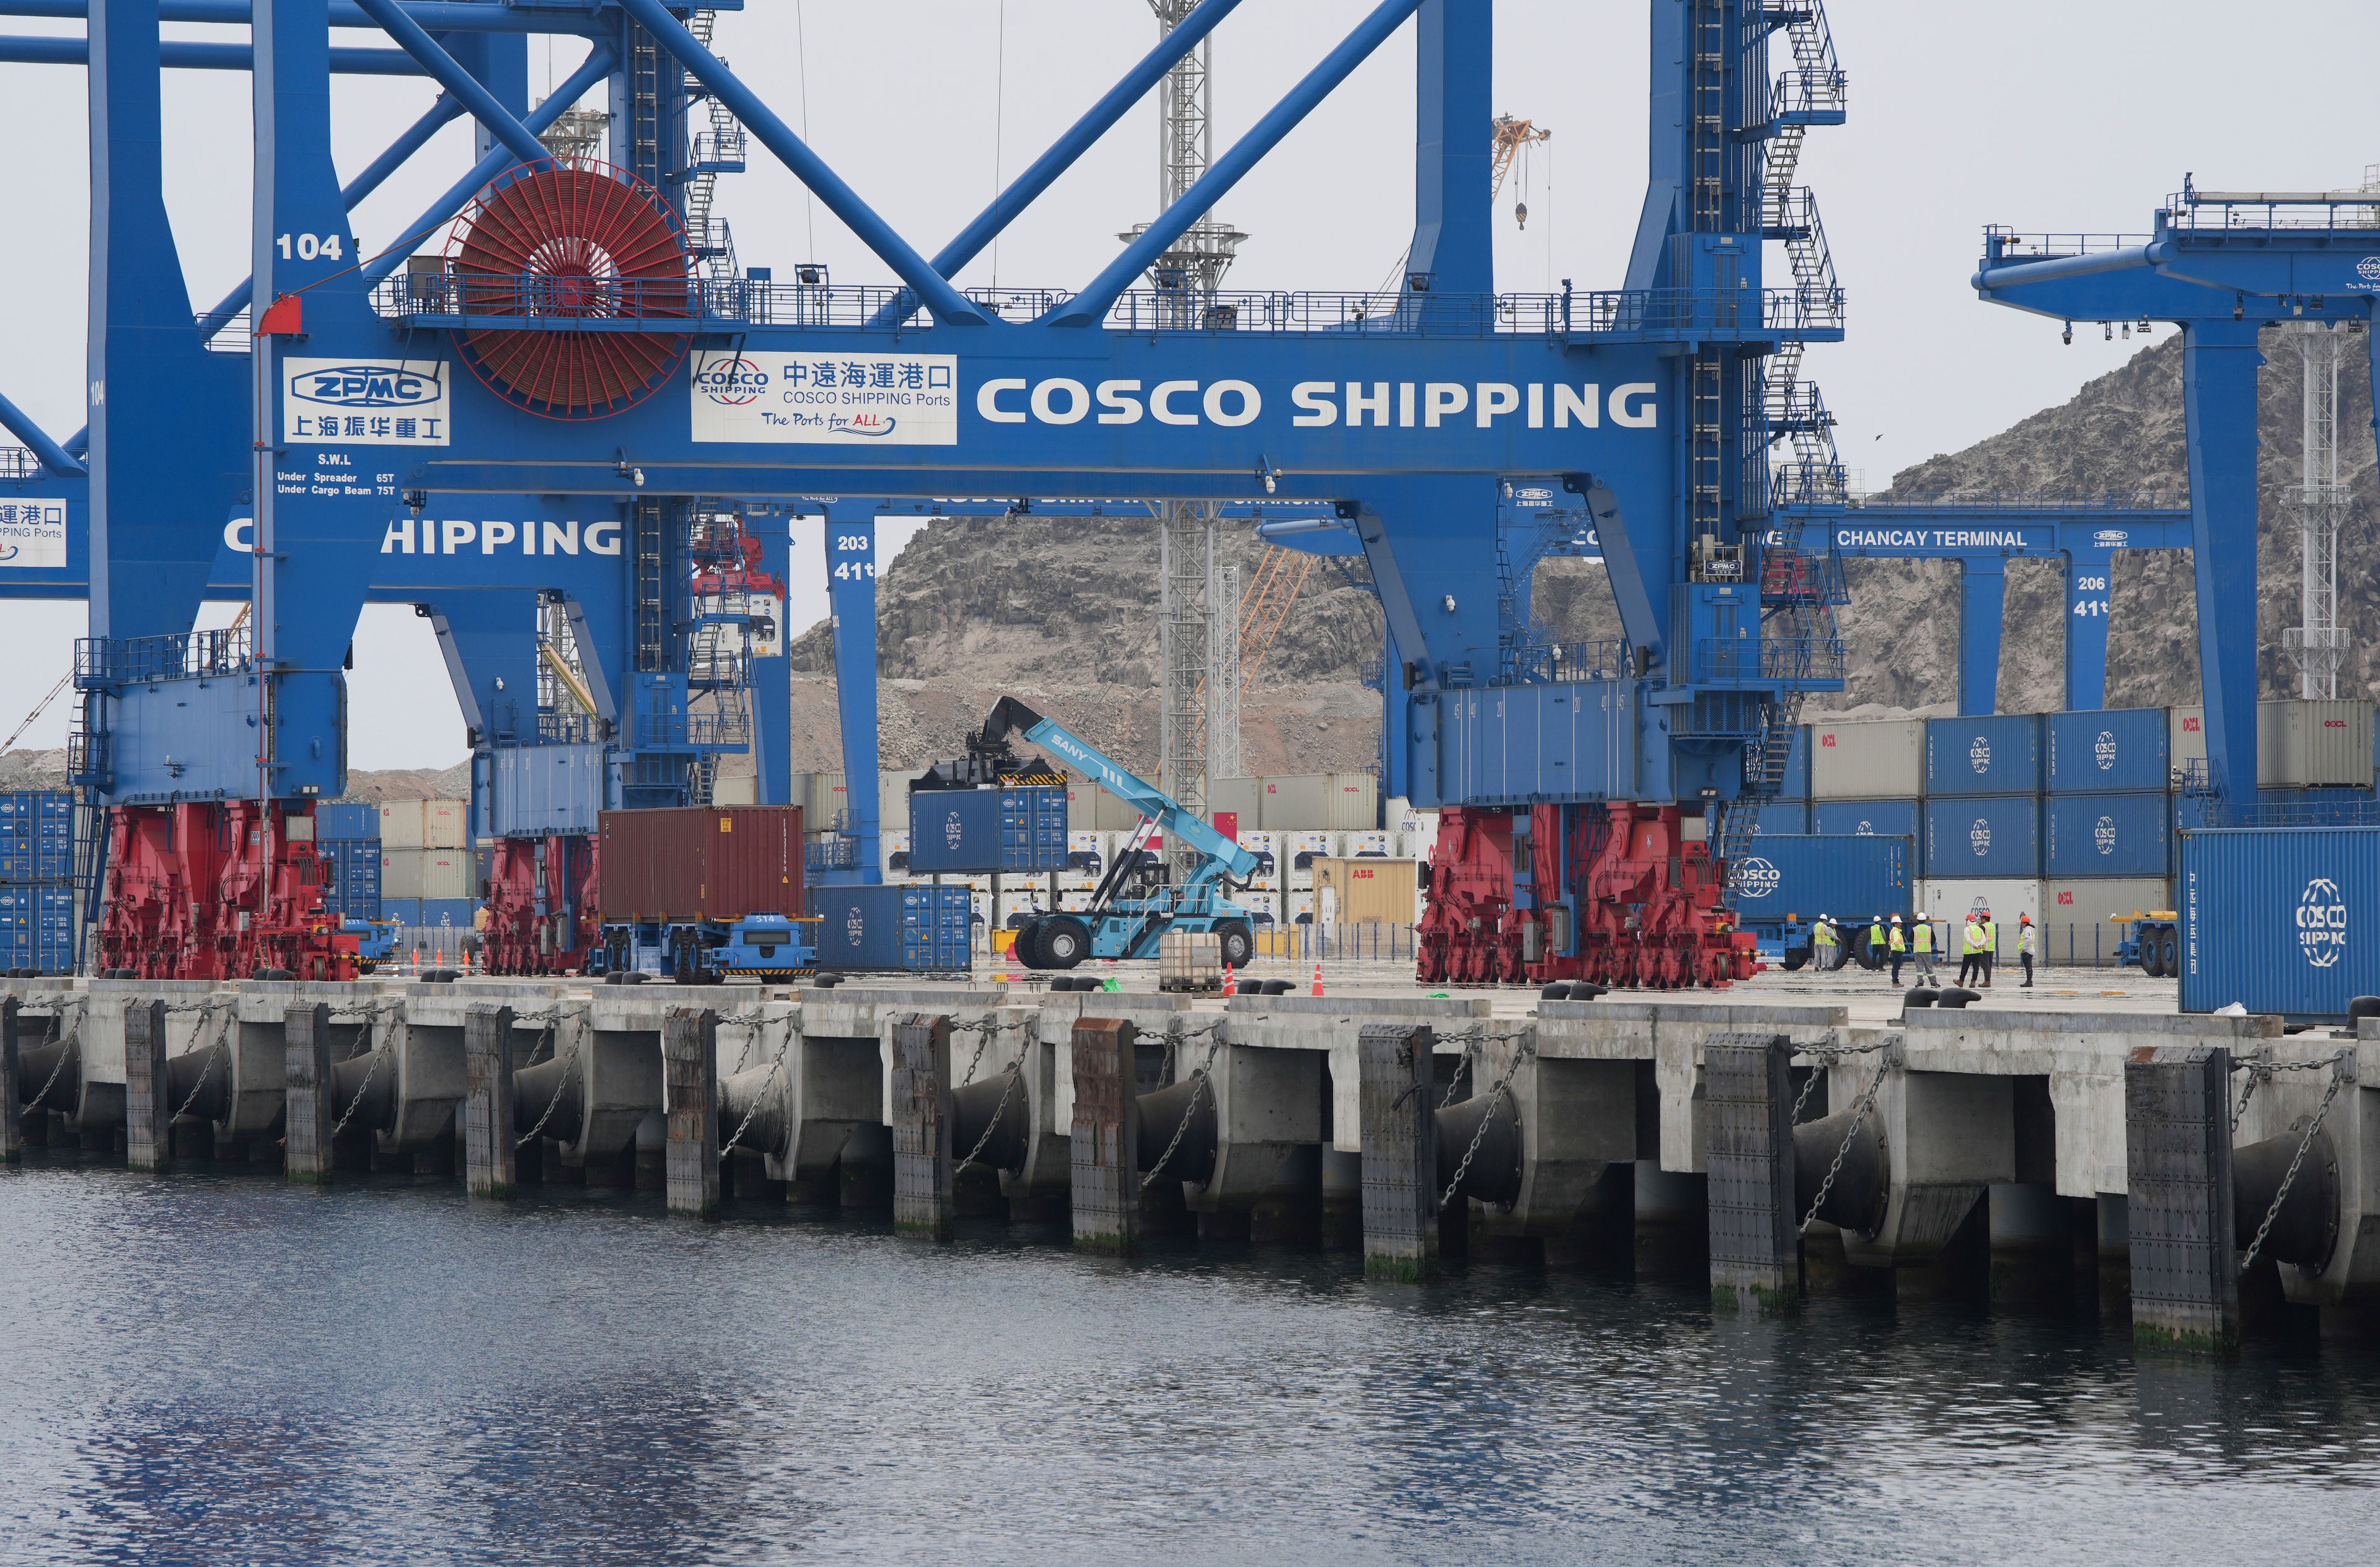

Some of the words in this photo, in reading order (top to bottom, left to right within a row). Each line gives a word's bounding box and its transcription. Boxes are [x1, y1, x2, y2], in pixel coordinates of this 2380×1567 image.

[276, 234, 342, 260] 104
[697, 373, 769, 385] COSCO
[783, 360, 951, 389] 中遠海運港口
[90, 380, 104, 406] 104
[314, 377, 422, 400] ZPMC
[783, 392, 837, 403] COSCO
[842, 392, 911, 405] SHIPPING
[916, 393, 950, 406] Ports
[976, 378, 1262, 427] COSCO
[1291, 382, 1657, 428] SHIPPING
[292, 416, 442, 439] 上海振华重工
[761, 412, 790, 426] The
[793, 413, 824, 426] Ports
[827, 413, 850, 430] for
[852, 414, 880, 426] ALL
[318, 454, 351, 465] S.W.L
[278, 472, 306, 481] Under
[314, 473, 357, 483] Spreader
[376, 474, 394, 483] 65T
[278, 485, 306, 494] Under
[311, 486, 340, 496] Cargo
[345, 486, 371, 495] Beam
[377, 486, 395, 495] 75T
[35, 529, 61, 538] Ports
[381, 519, 620, 555] HIPPING
[1838, 530, 1928, 546] CHANCAY
[1933, 532, 2027, 546] TERMINAL
[839, 536, 868, 550] 203
[834, 562, 874, 580] 41t
[2078, 577, 2105, 590] 206
[2074, 600, 2109, 617] 41t
[832, 615, 840, 628] 203
[1051, 734, 1089, 761] SANY
[1970, 748, 1990, 757] COSCO
[2096, 743, 2116, 753] COSCO
[1401, 822, 1416, 832] COSC
[2095, 828, 2115, 838] COSCO
[1970, 830, 1990, 840] COSCO
[1352, 869, 1374, 879] ABB
[2296, 905, 2347, 928] COSCO
[2299, 931, 2346, 945] SIPPNG
